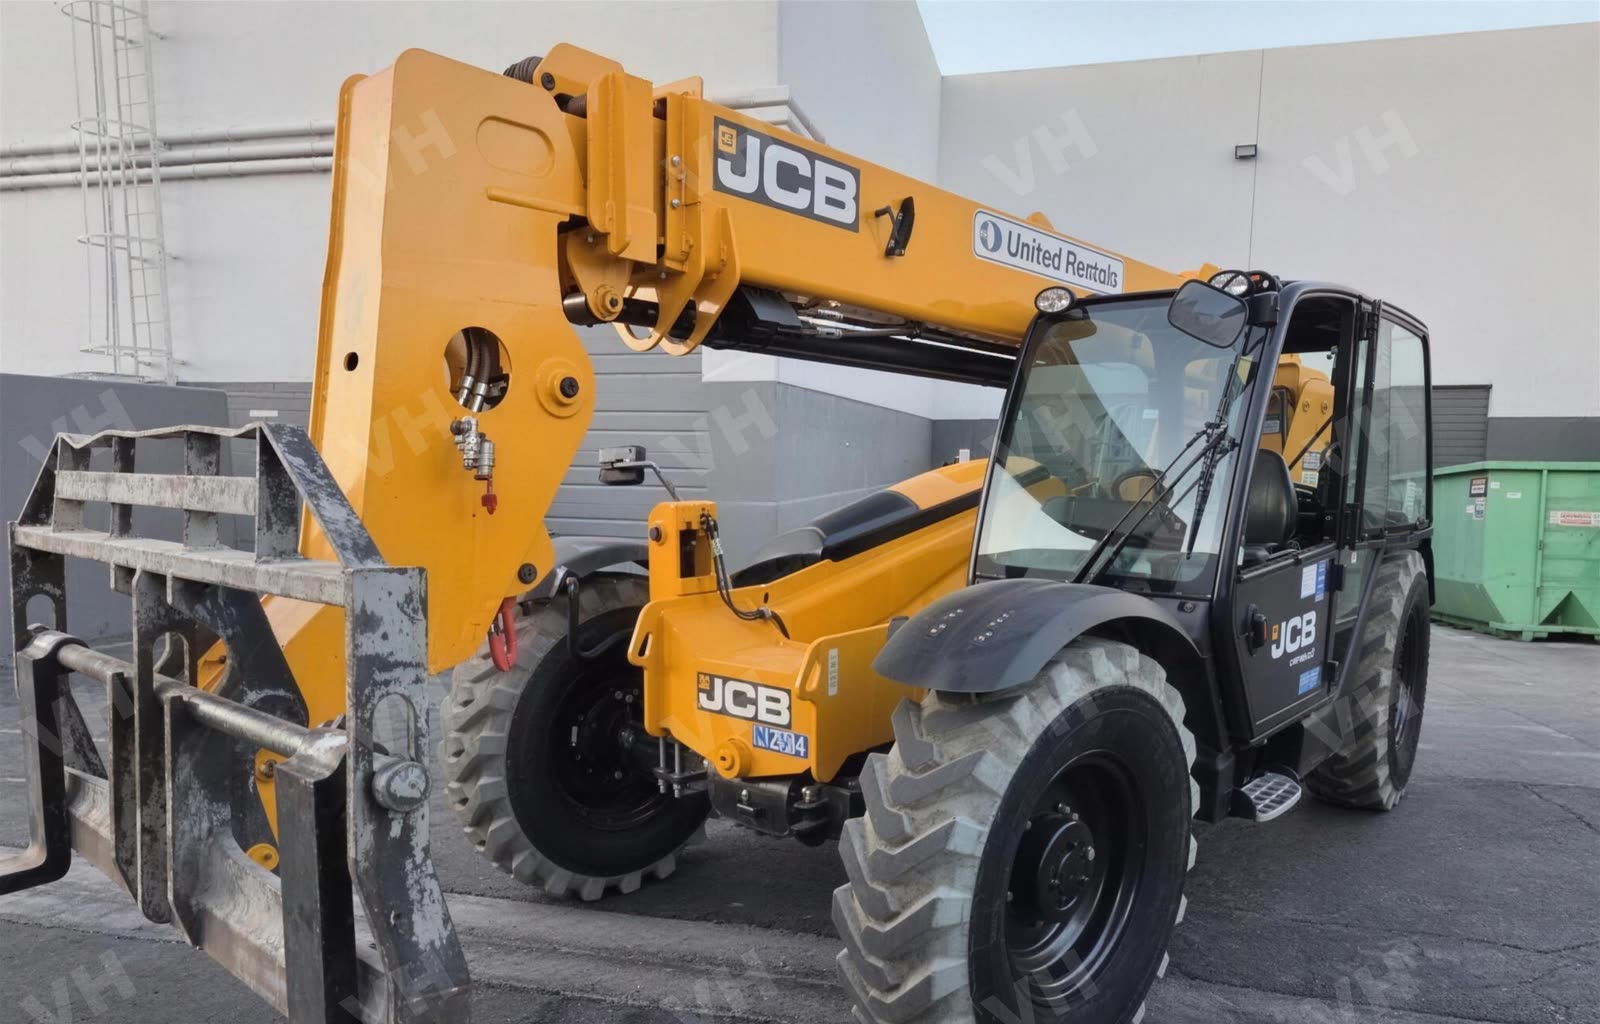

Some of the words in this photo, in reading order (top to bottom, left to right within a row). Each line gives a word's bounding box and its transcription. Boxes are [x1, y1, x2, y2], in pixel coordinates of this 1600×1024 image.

[717, 134, 857, 225] JCB
[1007, 230, 1062, 271] United
[1065, 249, 1118, 288] Rentals
[1271, 610, 1317, 659] JCB
[698, 677, 790, 726] JCB
